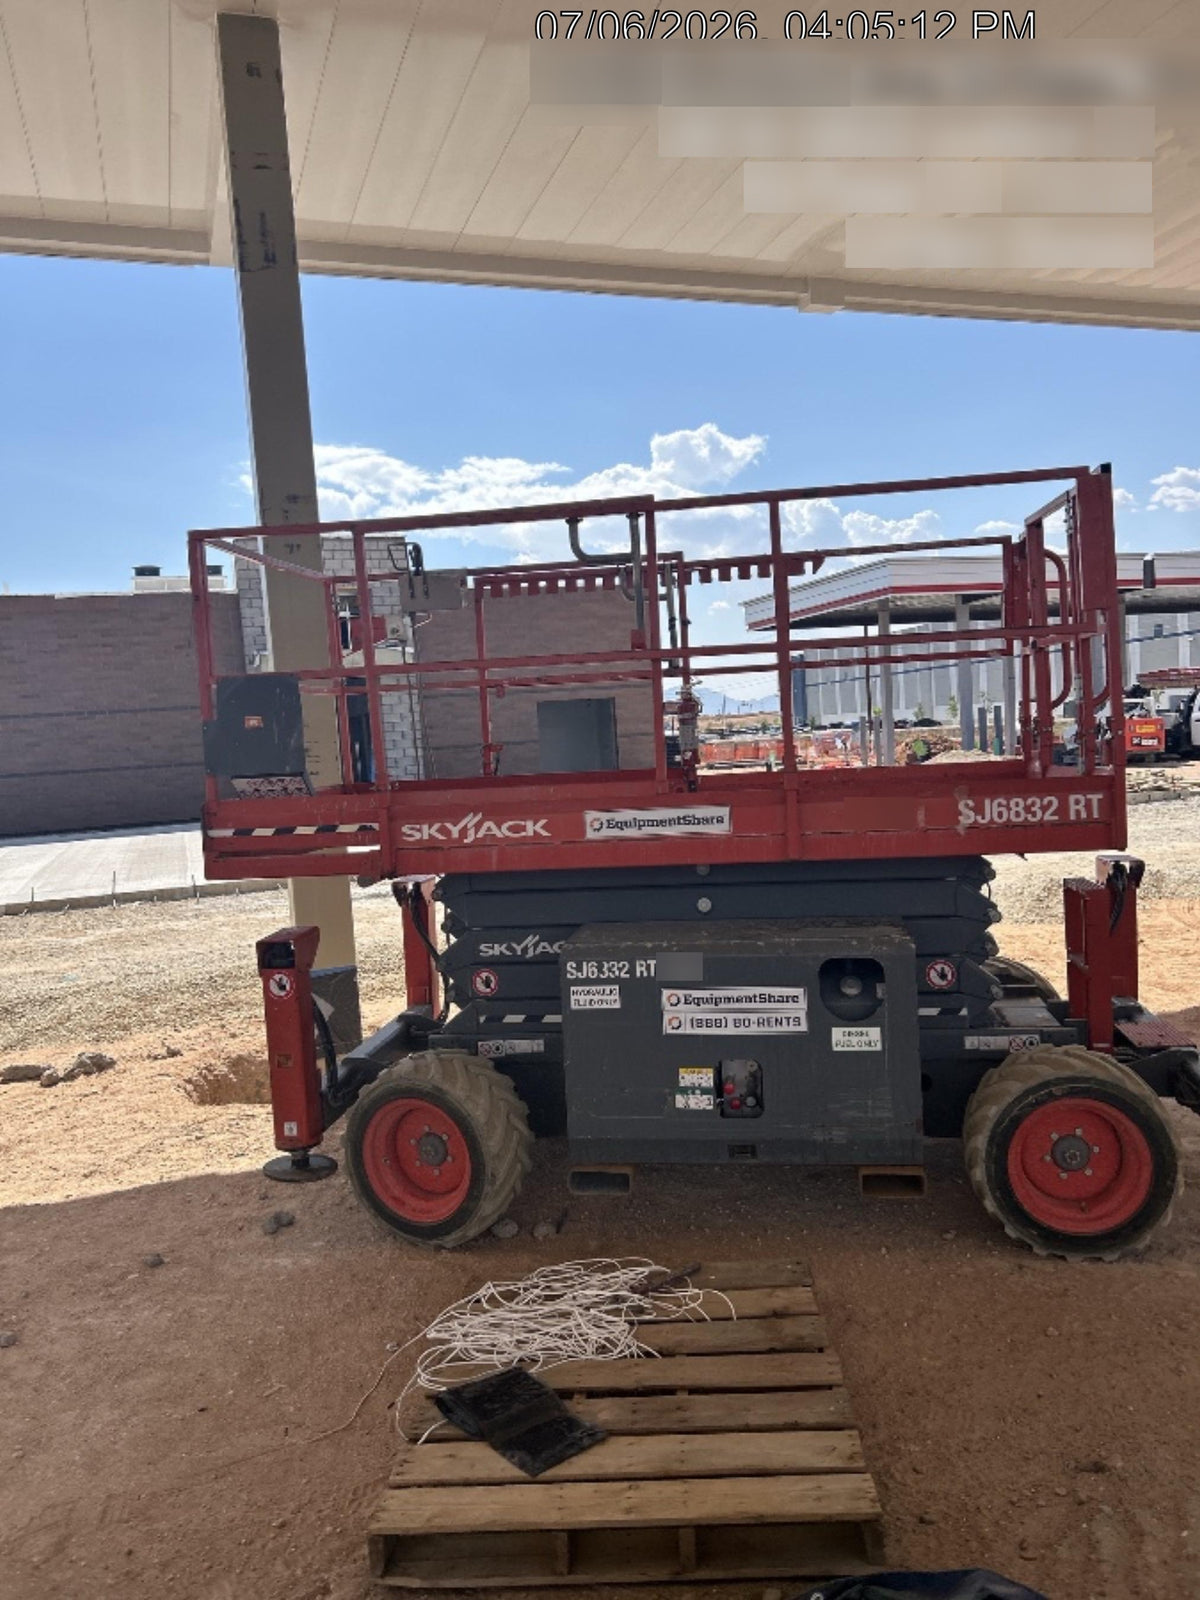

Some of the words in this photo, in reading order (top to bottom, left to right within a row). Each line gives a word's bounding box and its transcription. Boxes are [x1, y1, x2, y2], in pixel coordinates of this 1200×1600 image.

[958, 796, 1059, 824] SJ6832
[1069, 794, 1103, 820] RT
[401, 811, 551, 843] SKYJACK
[605, 814, 724, 831] EquipmentShare
[479, 934, 565, 959] SKYJAC
[635, 959, 656, 978] RT
[683, 993, 799, 1006] EquipmentShare
[690, 1016, 728, 1029] (888)
